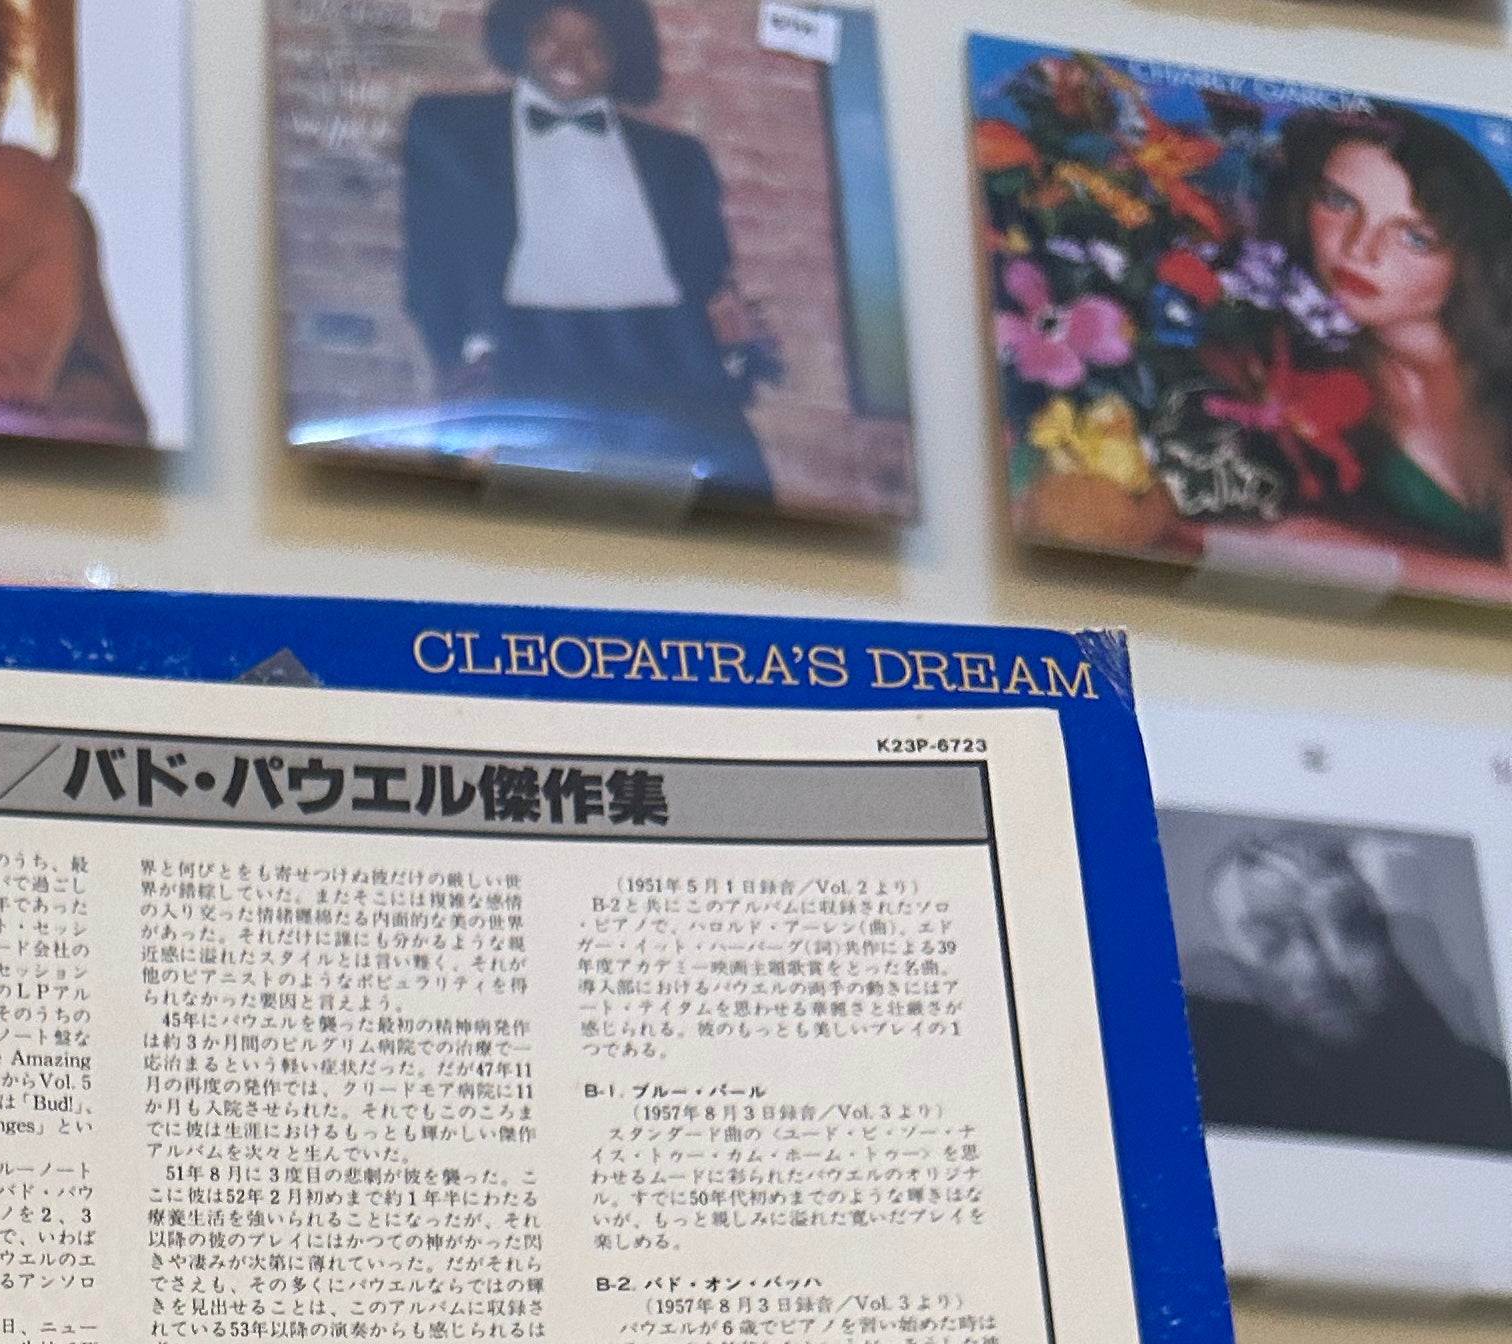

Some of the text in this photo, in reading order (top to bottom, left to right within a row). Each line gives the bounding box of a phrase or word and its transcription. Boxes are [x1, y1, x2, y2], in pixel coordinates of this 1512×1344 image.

[412, 630, 1100, 701] CLEOPATRA'S DREAM
[876, 737, 988, 753] K23P-6723
